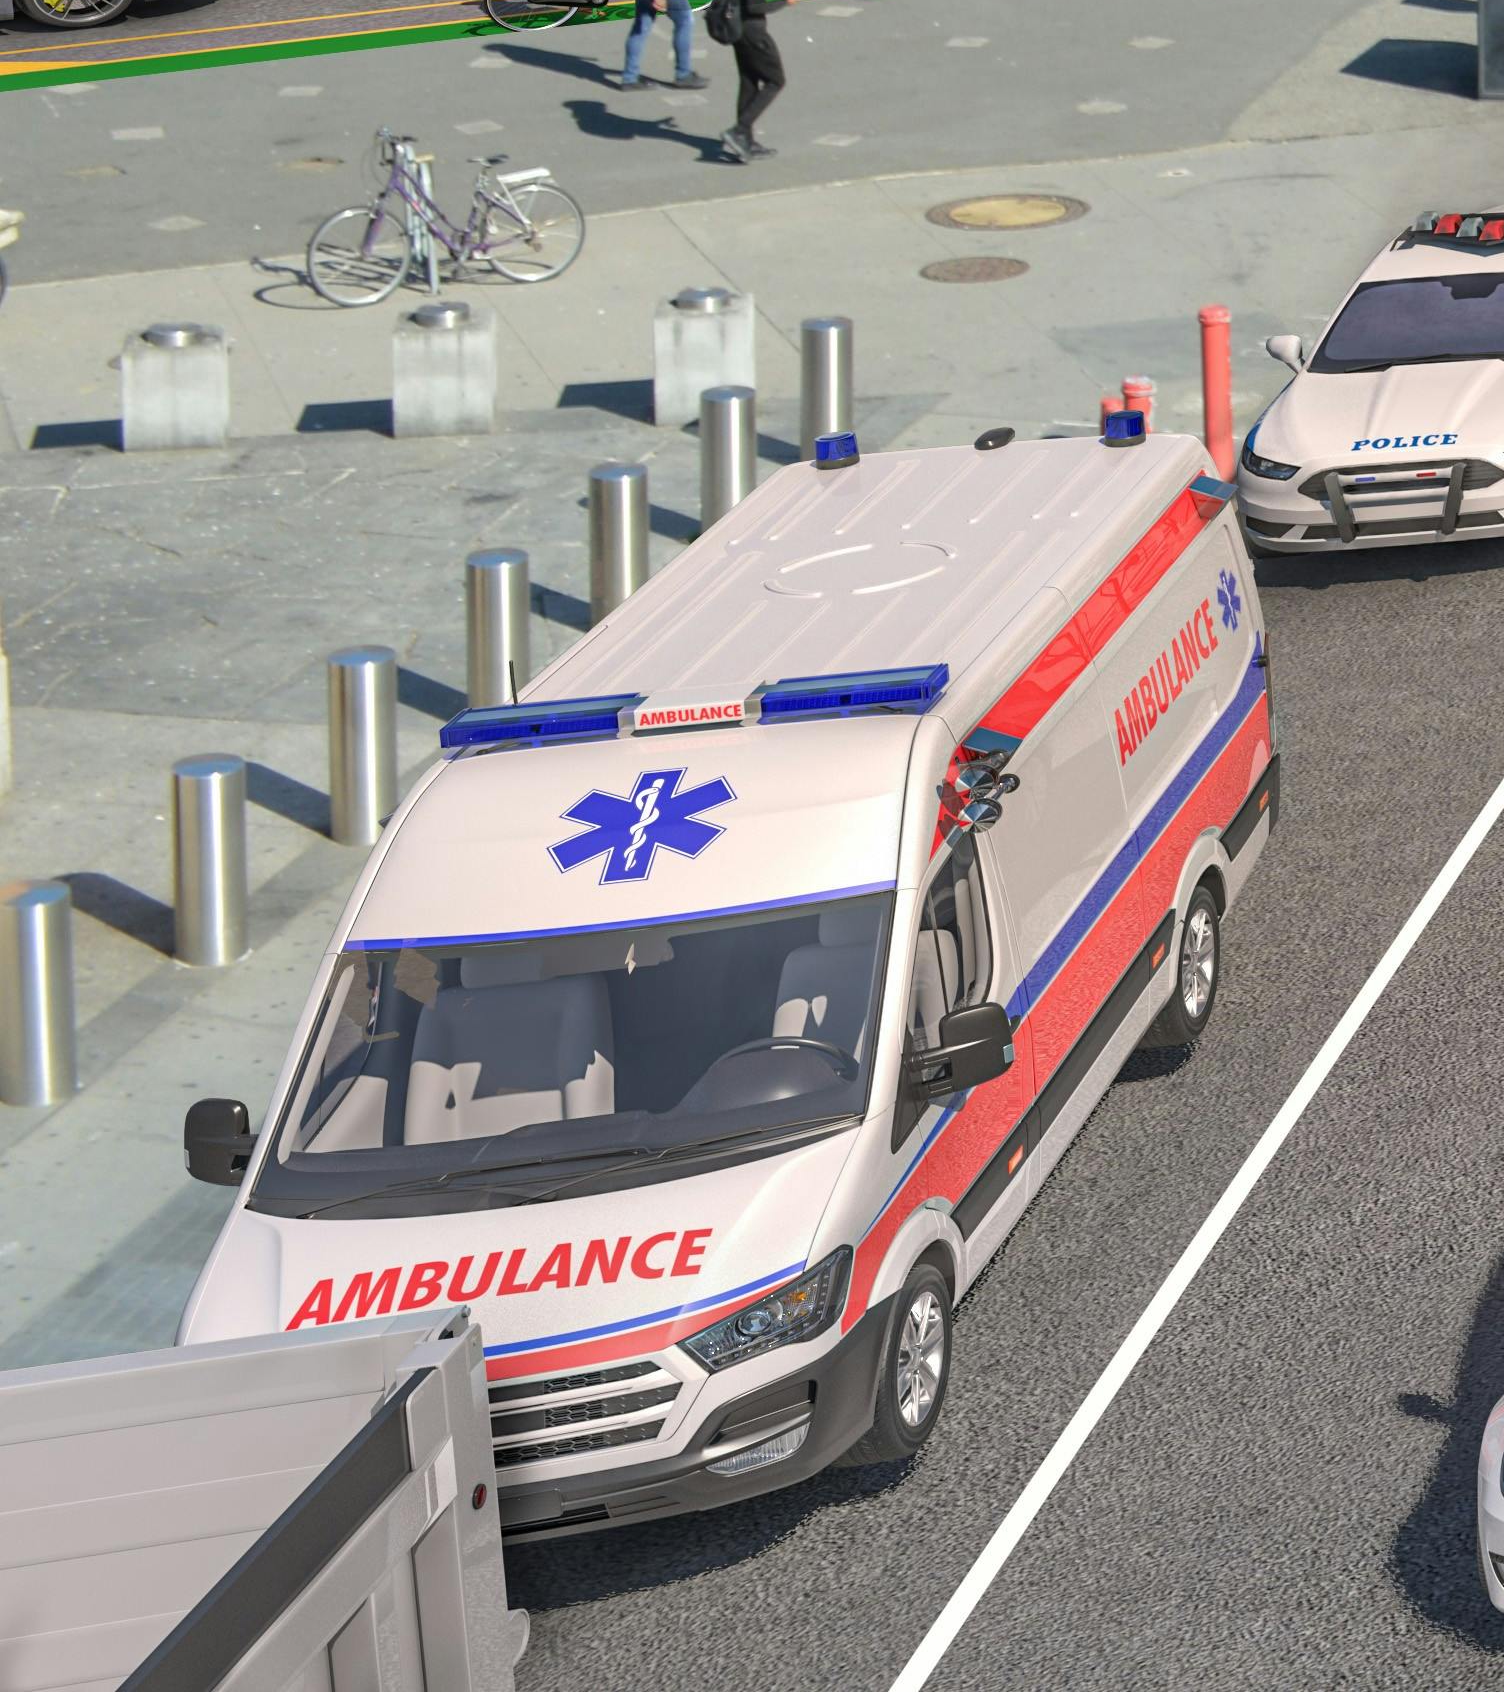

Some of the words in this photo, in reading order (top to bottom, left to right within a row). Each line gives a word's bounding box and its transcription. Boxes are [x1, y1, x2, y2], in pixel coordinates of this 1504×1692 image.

[1351, 432, 1458, 451] POLICE
[638, 703, 743, 727] AMBULANCE
[1115, 601, 1219, 765] AMBULANCE
[284, 1227, 713, 1331] AMBULANCE
